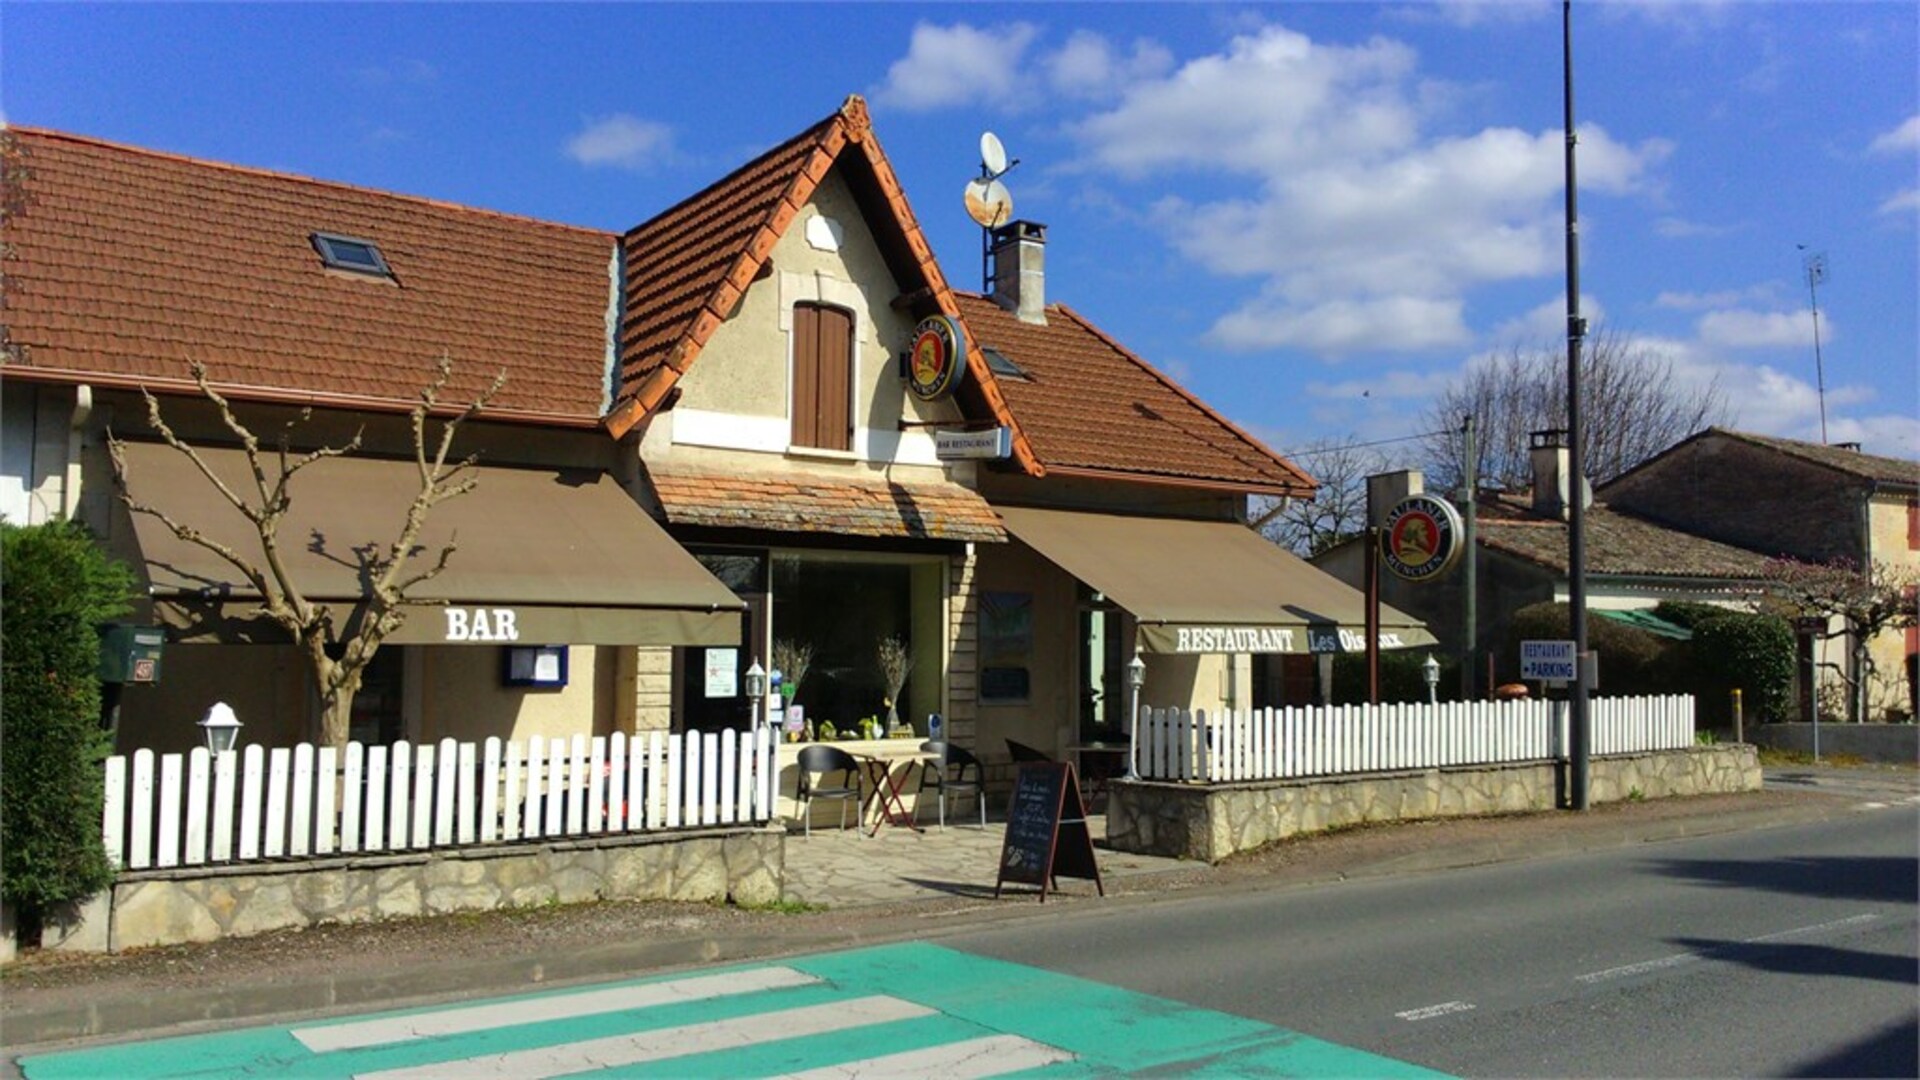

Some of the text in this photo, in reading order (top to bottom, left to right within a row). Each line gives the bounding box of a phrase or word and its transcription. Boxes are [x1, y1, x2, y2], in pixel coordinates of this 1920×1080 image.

[952, 438, 995, 449] RESTAURANT
[444, 608, 519, 641] BAR
[1177, 627, 1404, 653] RESTAURANT Les Oisux
[1524, 643, 1570, 658] RESTAURANT
[1531, 662, 1574, 678] PARKING
